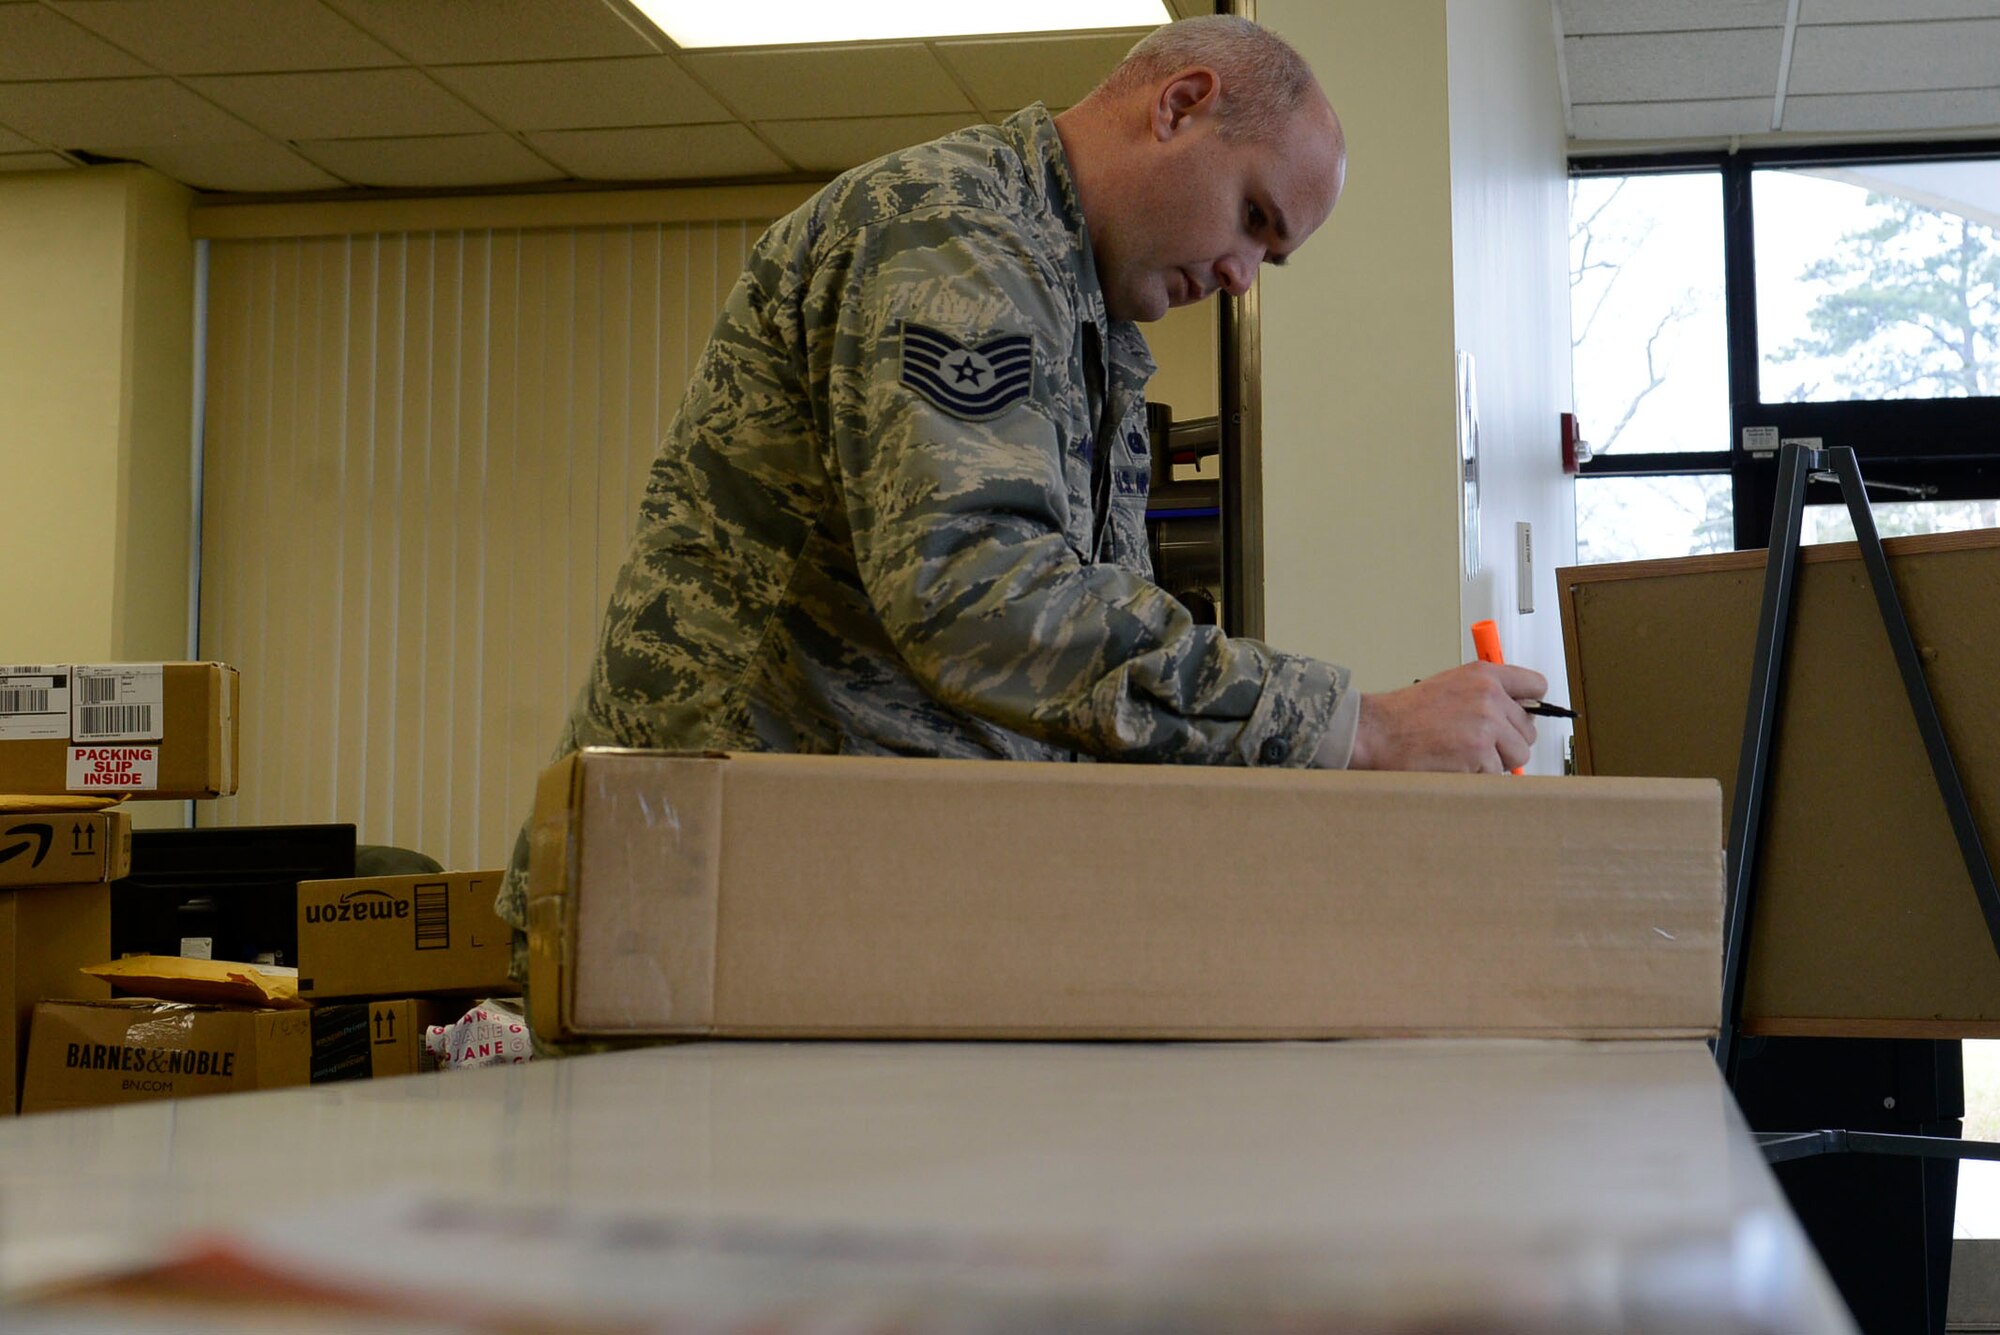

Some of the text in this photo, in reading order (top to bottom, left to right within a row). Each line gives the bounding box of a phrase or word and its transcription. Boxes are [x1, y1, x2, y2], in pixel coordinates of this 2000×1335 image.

[75, 749, 153, 761] PACKING
[94, 761, 133, 773] SLIP
[84, 773, 142, 785] INSIDE
[306, 897, 409, 923] amazon
[122, 1079, 173, 1092] BN.COM
